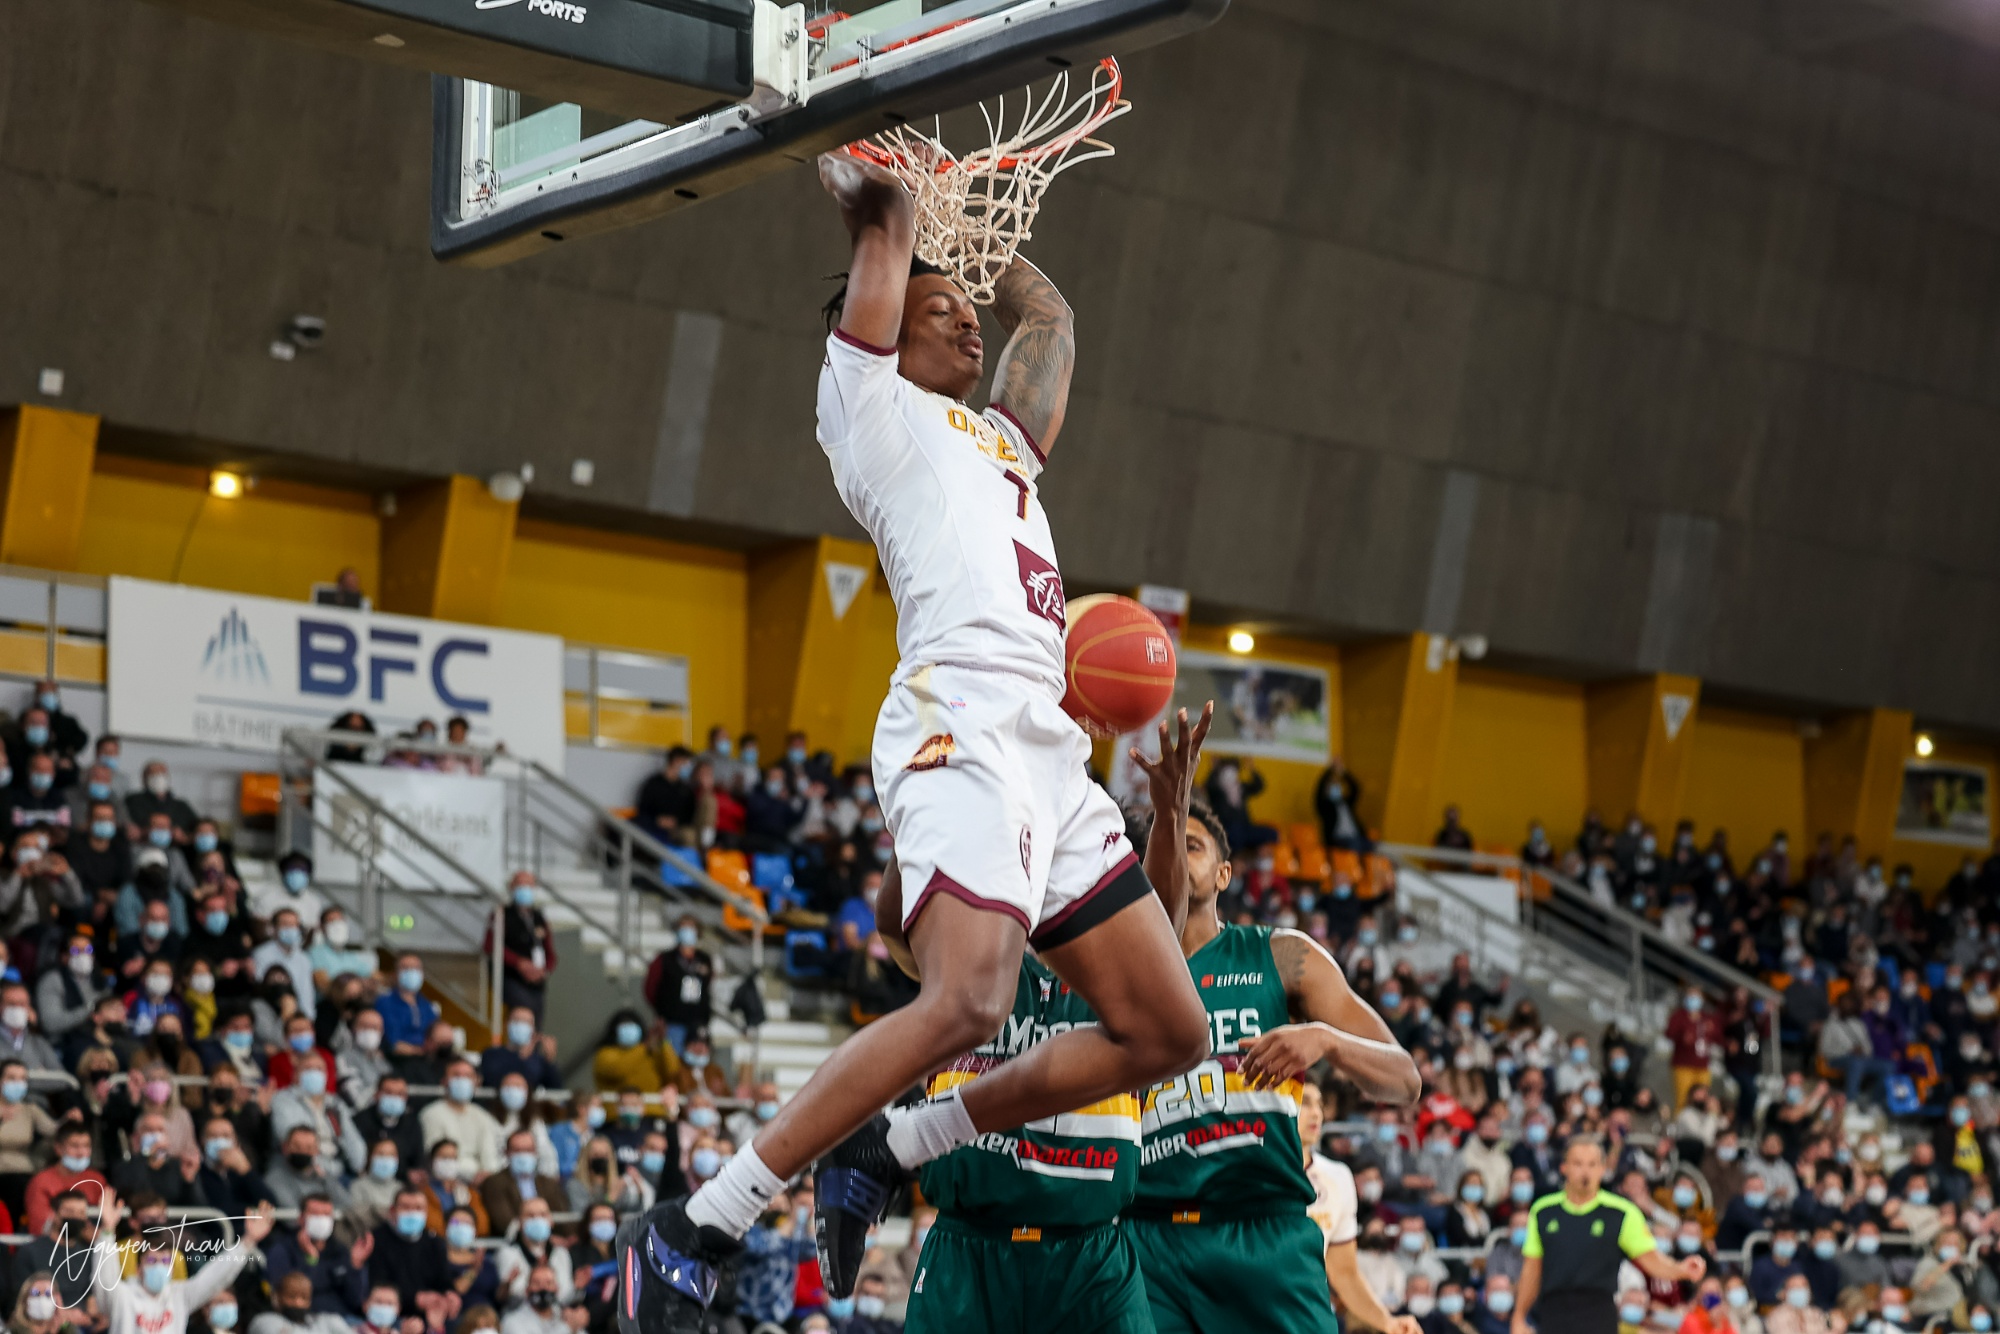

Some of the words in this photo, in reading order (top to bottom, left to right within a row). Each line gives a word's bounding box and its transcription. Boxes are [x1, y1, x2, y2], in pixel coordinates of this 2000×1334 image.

[1003, 468, 1030, 521] 7
[297, 617, 490, 714] BFC
[1216, 972, 1264, 988] EIFFAGE
[1150, 1058, 1227, 1128] 20
